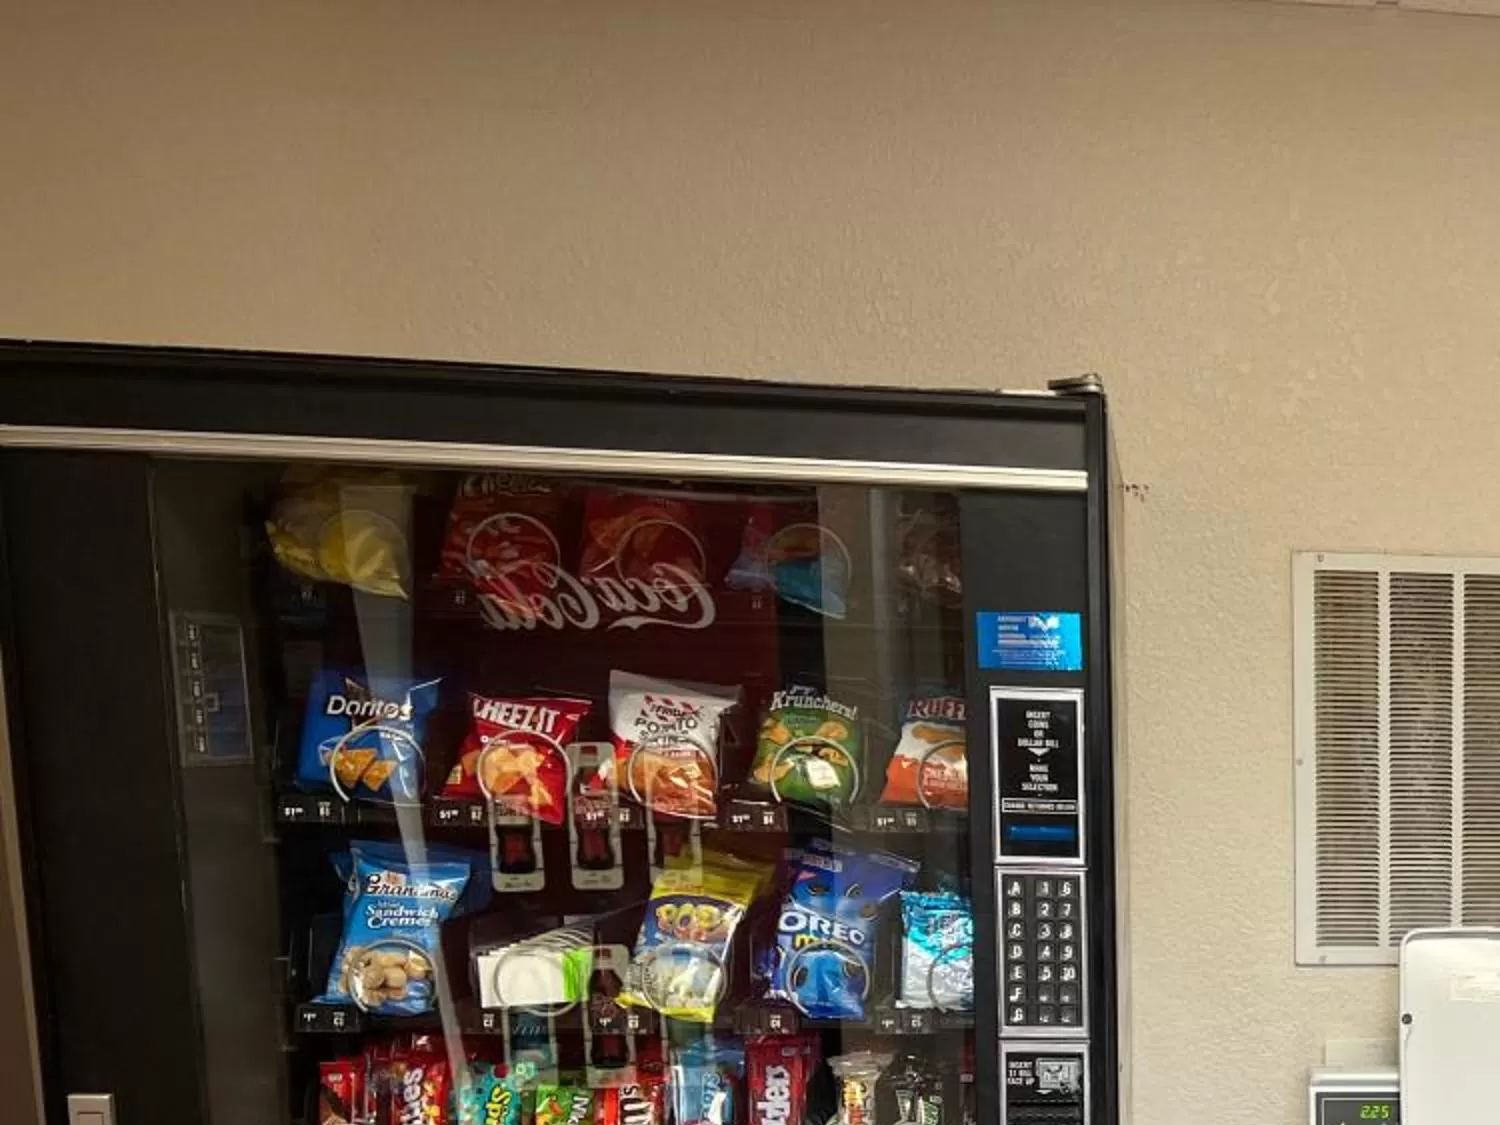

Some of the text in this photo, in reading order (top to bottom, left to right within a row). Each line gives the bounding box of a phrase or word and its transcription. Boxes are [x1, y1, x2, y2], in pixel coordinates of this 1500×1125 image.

[326, 695, 413, 721] Doritos
[473, 698, 560, 733] CHEEZ-IT
[1010, 881, 1021, 896] A
[365, 903, 438, 920] Sandwich
[1011, 902, 1071, 917] B 2 7
[779, 911, 865, 945] OREO
[1012, 923, 1021, 937] C
[1040, 924, 1051, 939] 3
[1012, 945, 1023, 959] D
[1063, 945, 1073, 960] 9
[1040, 965, 1052, 980] 5
[1360, 1104, 1391, 1120] 225
